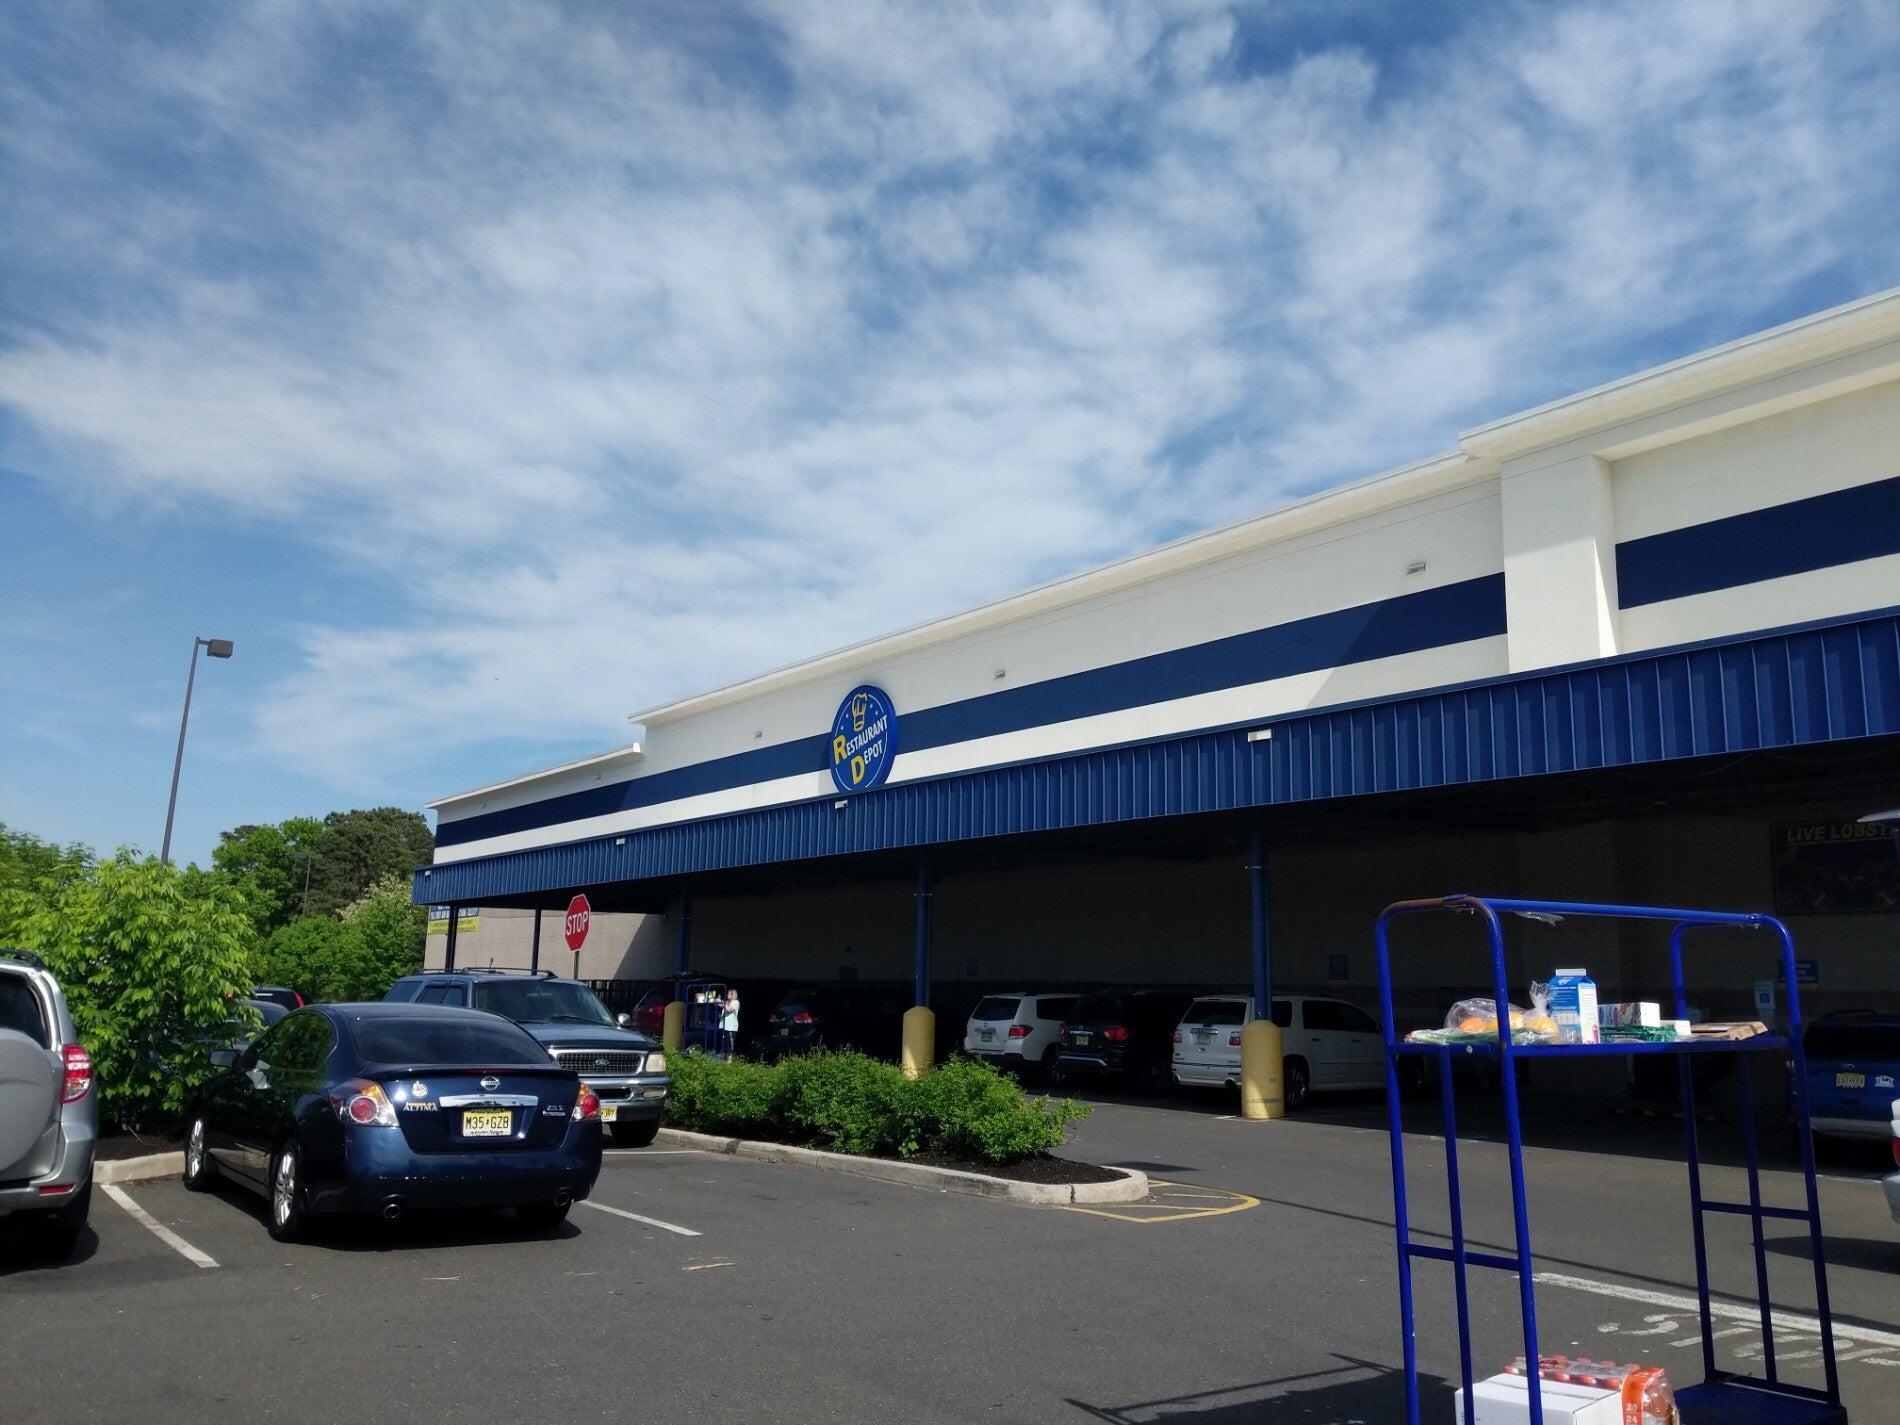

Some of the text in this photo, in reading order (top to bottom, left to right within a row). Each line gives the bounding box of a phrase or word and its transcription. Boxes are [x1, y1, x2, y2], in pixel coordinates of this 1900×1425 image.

[833, 715, 888, 765] RESTAURANT
[851, 740, 883, 785] DEPOT
[1787, 822, 1888, 842] LIVE LOBST
[566, 911, 588, 936] STOP
